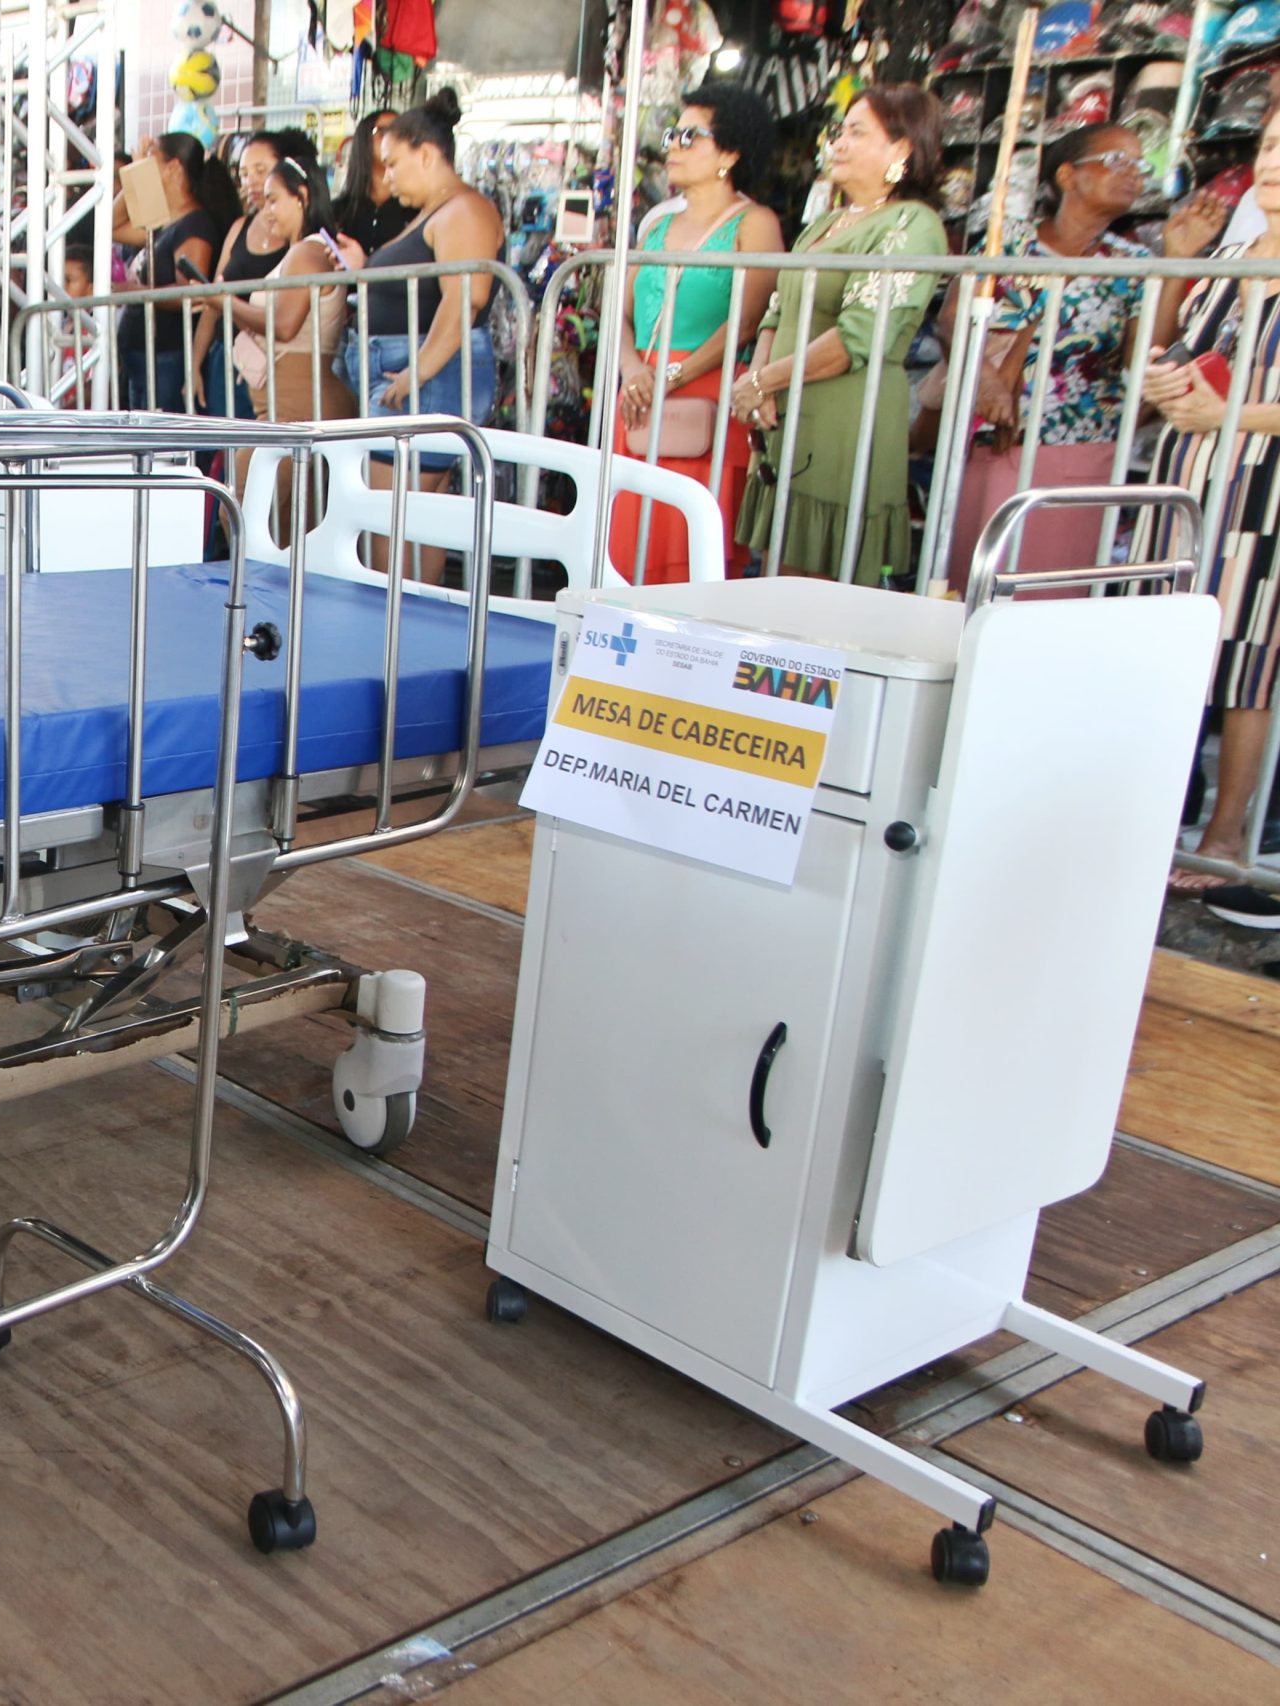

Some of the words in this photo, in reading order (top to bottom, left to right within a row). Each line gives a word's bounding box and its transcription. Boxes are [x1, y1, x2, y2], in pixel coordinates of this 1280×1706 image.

[584, 630, 609, 648] SUS
[732, 660, 836, 709] BAHIA
[740, 650, 787, 668] GOVERNO
[788, 660, 802, 671] DO
[804, 663, 841, 679] ESTADO
[572, 693, 631, 727] MESA
[637, 709, 667, 735] DE
[671, 717, 807, 769] CABECEIRA
[543, 750, 651, 795] DEP.MARIA
[656, 780, 697, 808] DEL
[703, 793, 802, 836] CARMEN
